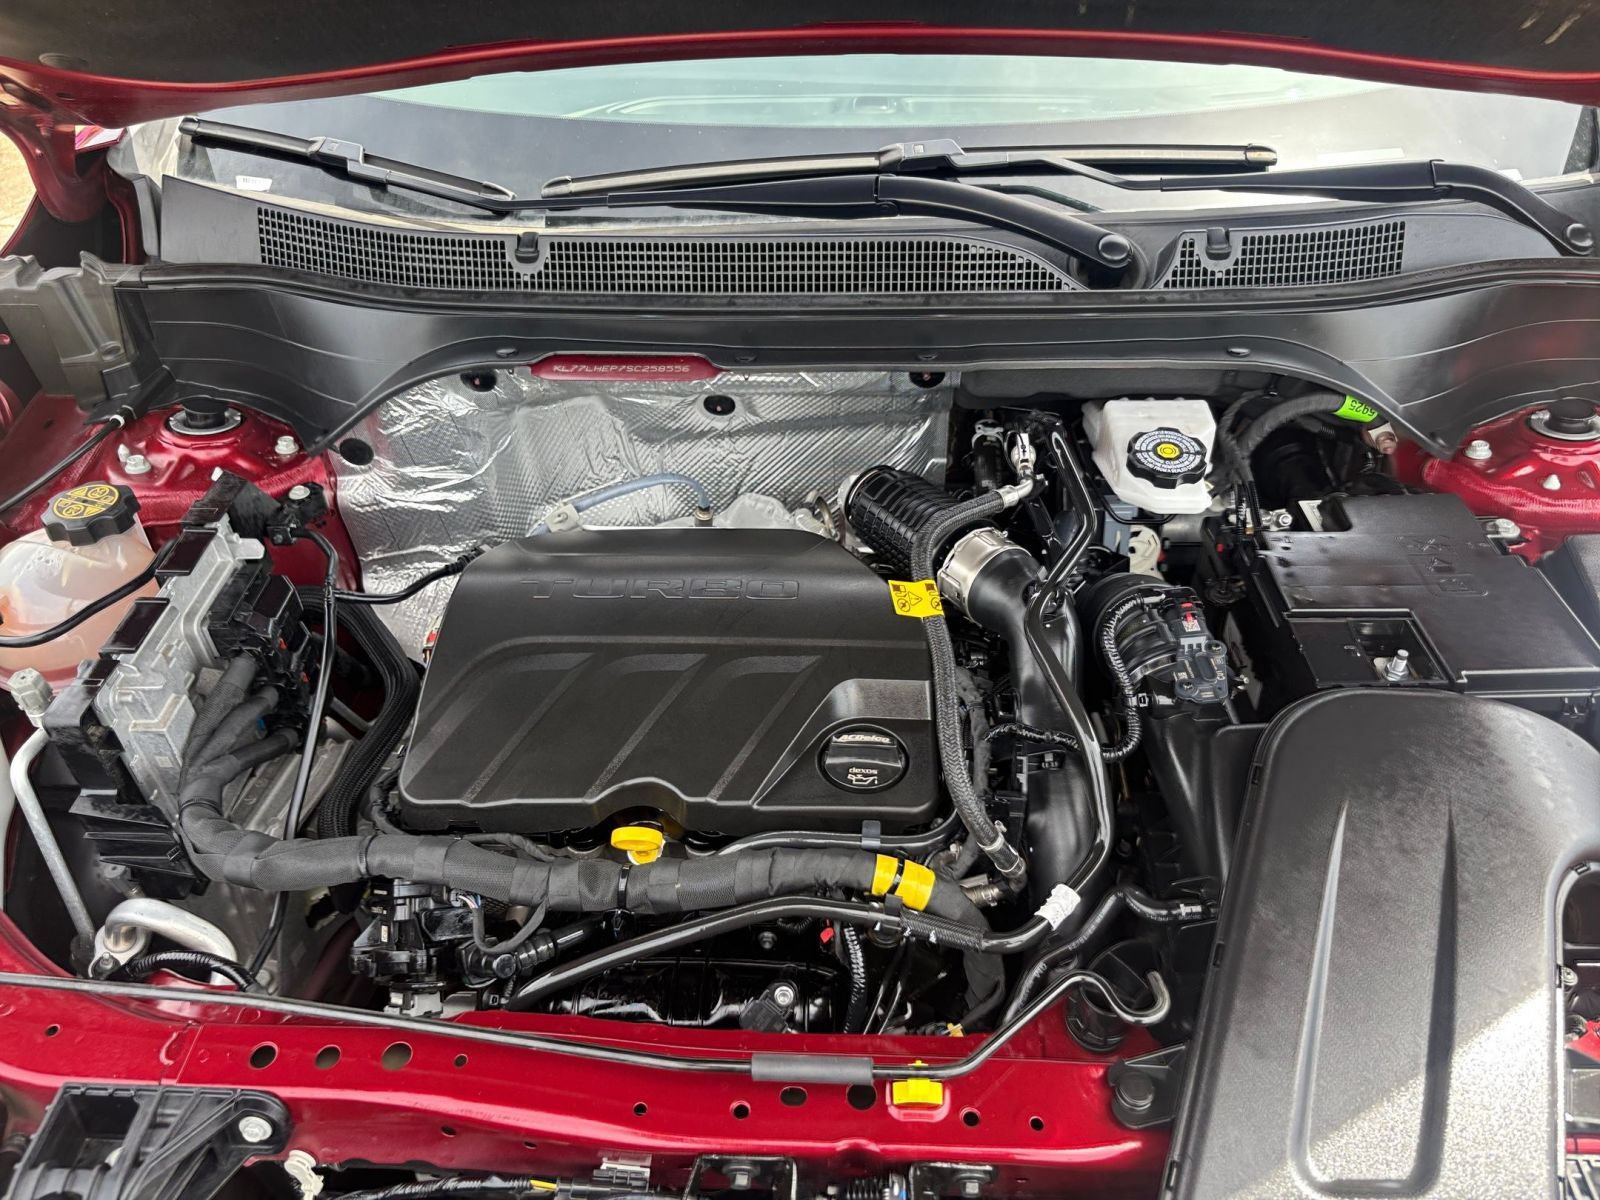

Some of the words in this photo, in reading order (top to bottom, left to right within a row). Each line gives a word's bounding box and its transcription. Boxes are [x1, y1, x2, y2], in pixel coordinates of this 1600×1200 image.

[553, 364, 690, 373] KL77LHEP7SC258556
[520, 577, 800, 600] TURBO
[834, 734, 892, 744] ACDelco
[848, 767, 878, 775] dexos
